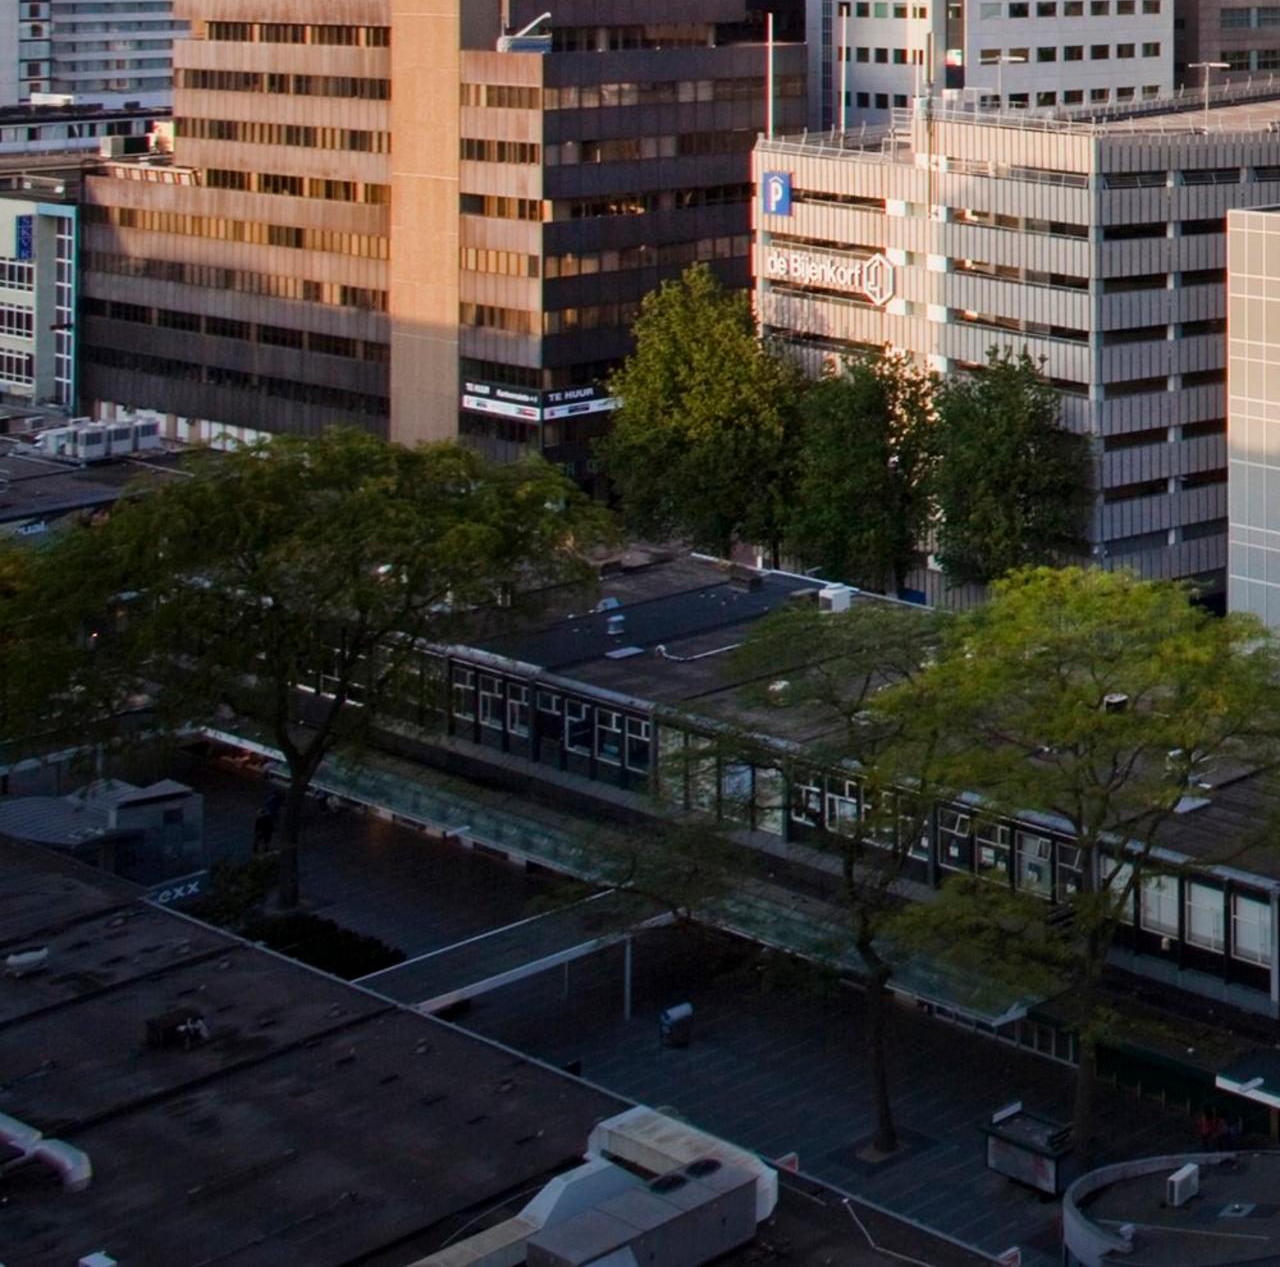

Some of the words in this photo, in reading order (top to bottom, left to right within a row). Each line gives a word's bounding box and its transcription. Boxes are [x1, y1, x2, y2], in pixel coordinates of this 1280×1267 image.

[770, 181, 783, 212] P
[768, 250, 788, 275] de
[790, 253, 861, 288] Bijenkorf
[549, 392, 563, 402] TE
[565, 387, 595, 400] HUUR
